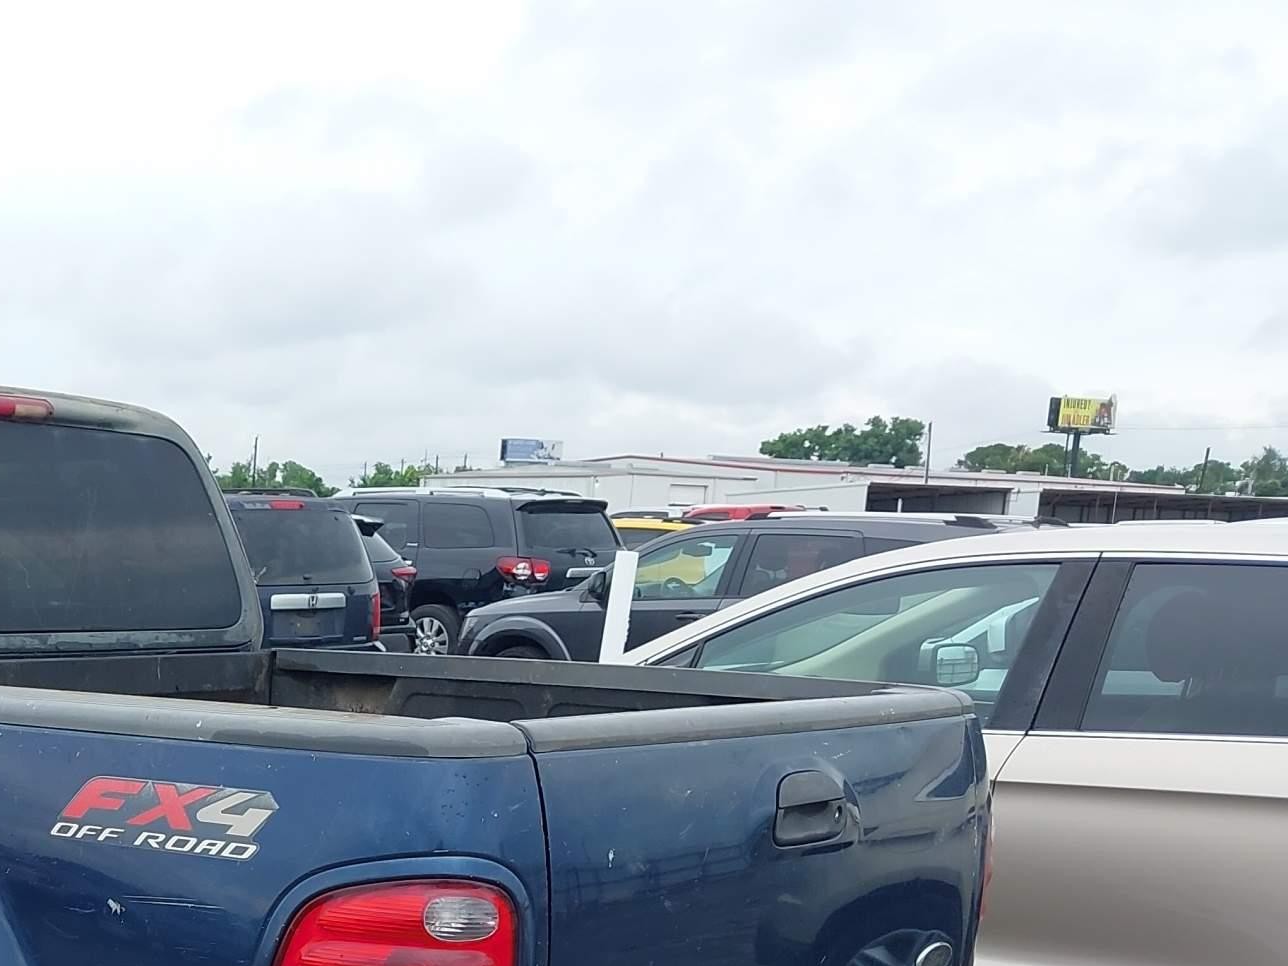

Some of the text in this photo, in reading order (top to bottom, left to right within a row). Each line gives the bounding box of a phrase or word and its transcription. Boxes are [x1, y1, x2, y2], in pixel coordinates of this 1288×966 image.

[63, 777, 273, 837] FX4
[50, 822, 257, 859] OFF ROAD
